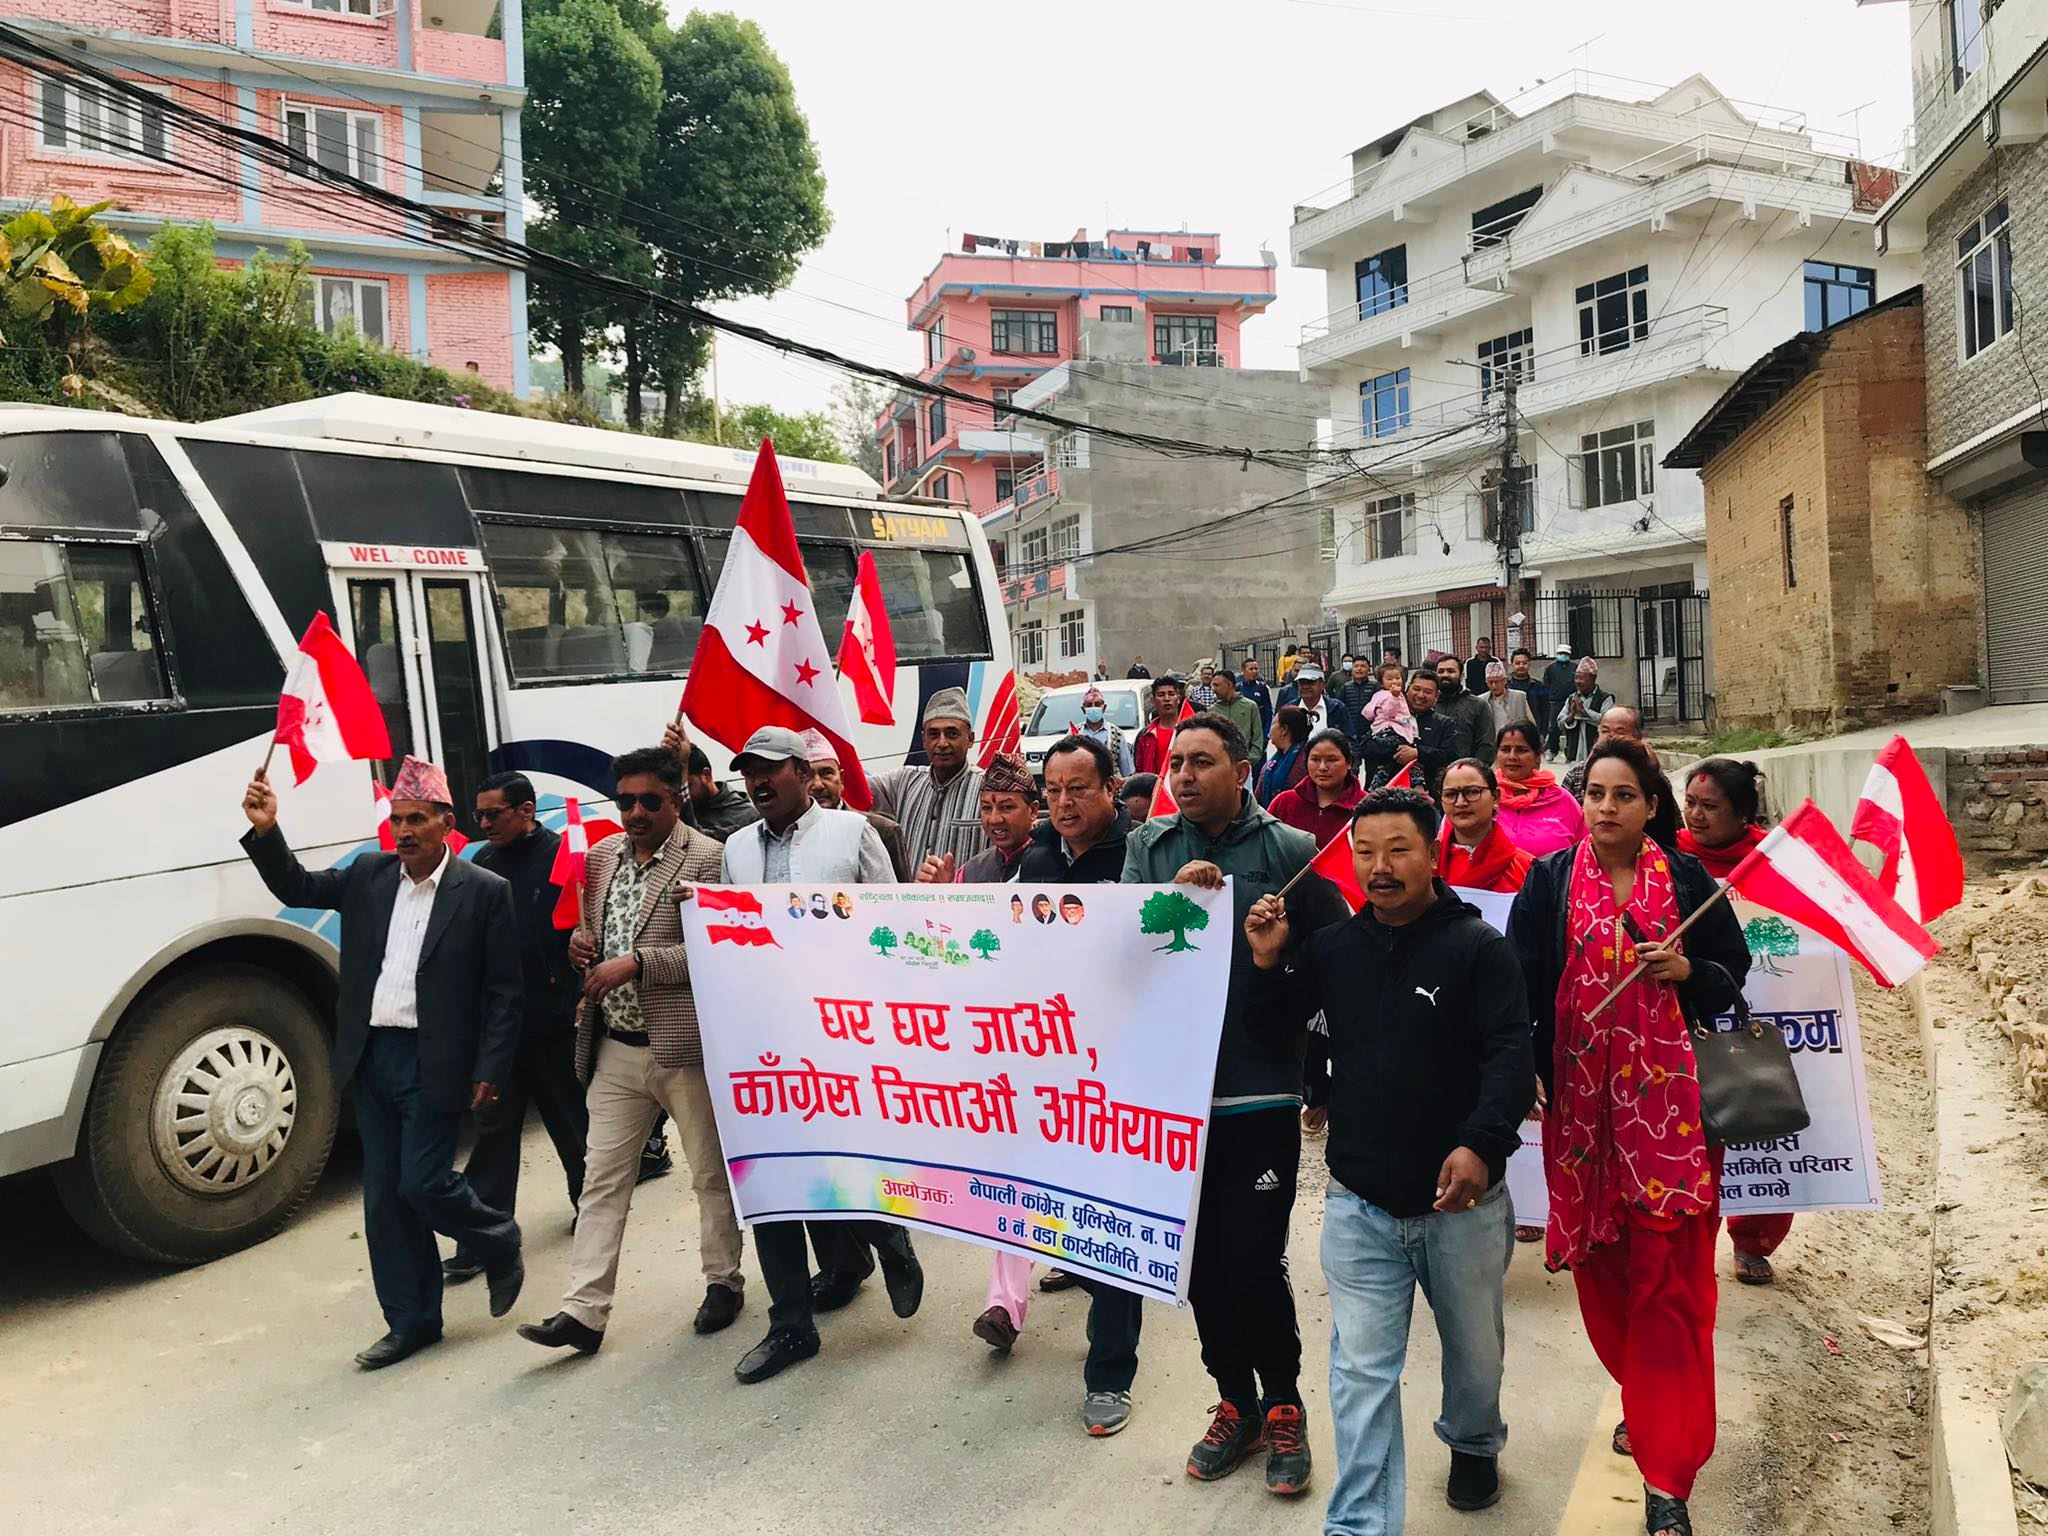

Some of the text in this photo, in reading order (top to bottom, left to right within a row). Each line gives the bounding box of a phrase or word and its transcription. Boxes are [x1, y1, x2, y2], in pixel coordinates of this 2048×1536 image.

[871, 515, 949, 543] SATYAM
[813, 997, 874, 1045] घर
[885, 1002, 950, 1051] घर
[729, 1051, 1204, 1172] काँग्रेस जिताऔ अभियान
[1789, 1154, 1854, 1174] परिवार
[968, 1177, 1017, 1205] नेपाली
[1747, 1178, 1791, 1198] काभ्रे
[1033, 1225, 1058, 1247] वडा
